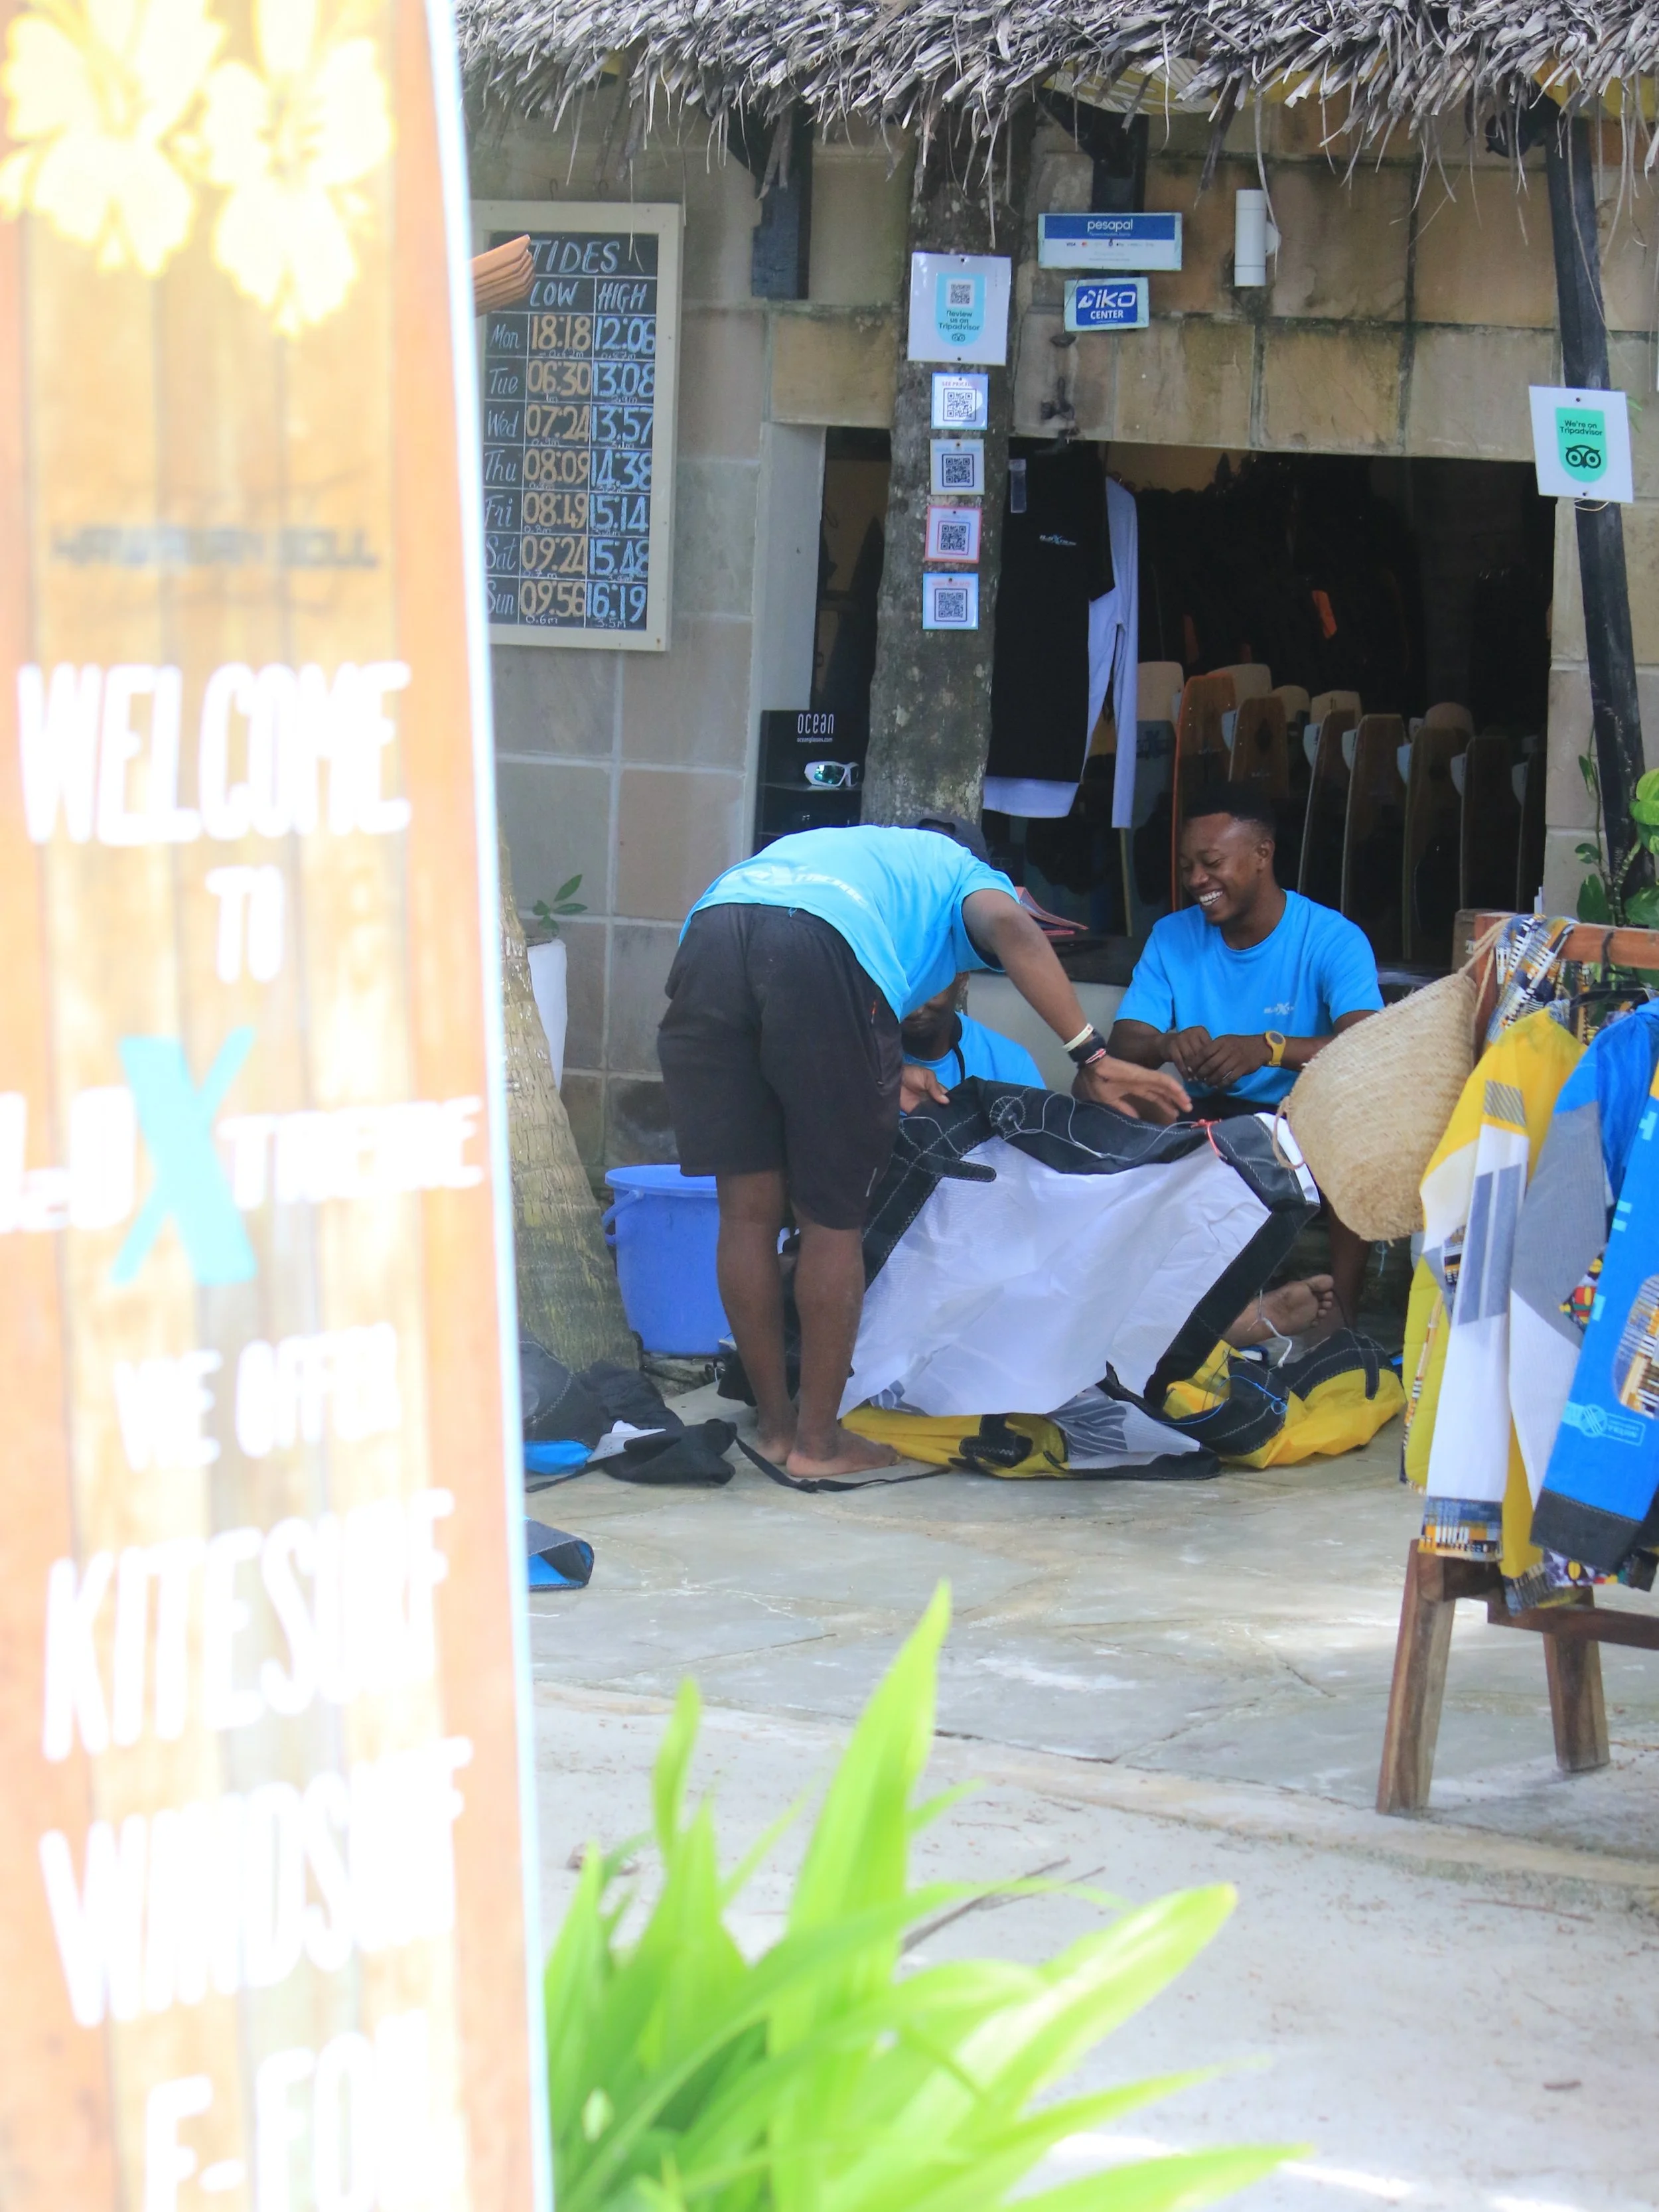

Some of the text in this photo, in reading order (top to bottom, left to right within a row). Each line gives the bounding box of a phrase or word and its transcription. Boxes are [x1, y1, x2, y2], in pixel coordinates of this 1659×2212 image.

[1087, 218, 1133, 232] pesapal
[531, 239, 620, 274] TIDES
[530, 281, 647, 314] LOW HIGH
[1090, 309, 1123, 320] CENTER
[489, 323, 521, 349] Mon
[532, 315, 592, 352] 18:18
[938, 322, 980, 331] Tripadvisor
[489, 359, 655, 398] Tue 06:30 13:08
[488, 409, 519, 438] Wed
[591, 405, 654, 445] 13:57
[1559, 426, 1603, 436] Tripadvisor
[1564, 419, 1586, 428] We're
[484, 448, 652, 491] Thu 08:09 14:38
[484, 494, 513, 528] Fri
[589, 493, 649, 533] 15:14
[485, 535, 517, 571] Sat
[589, 538, 649, 579] 15:48
[486, 580, 514, 615] Sun
[586, 581, 647, 623] 16:19
[797, 713, 834, 734] ocean
[18, 661, 411, 846] WELCOME
[205, 863, 285, 984] TO
